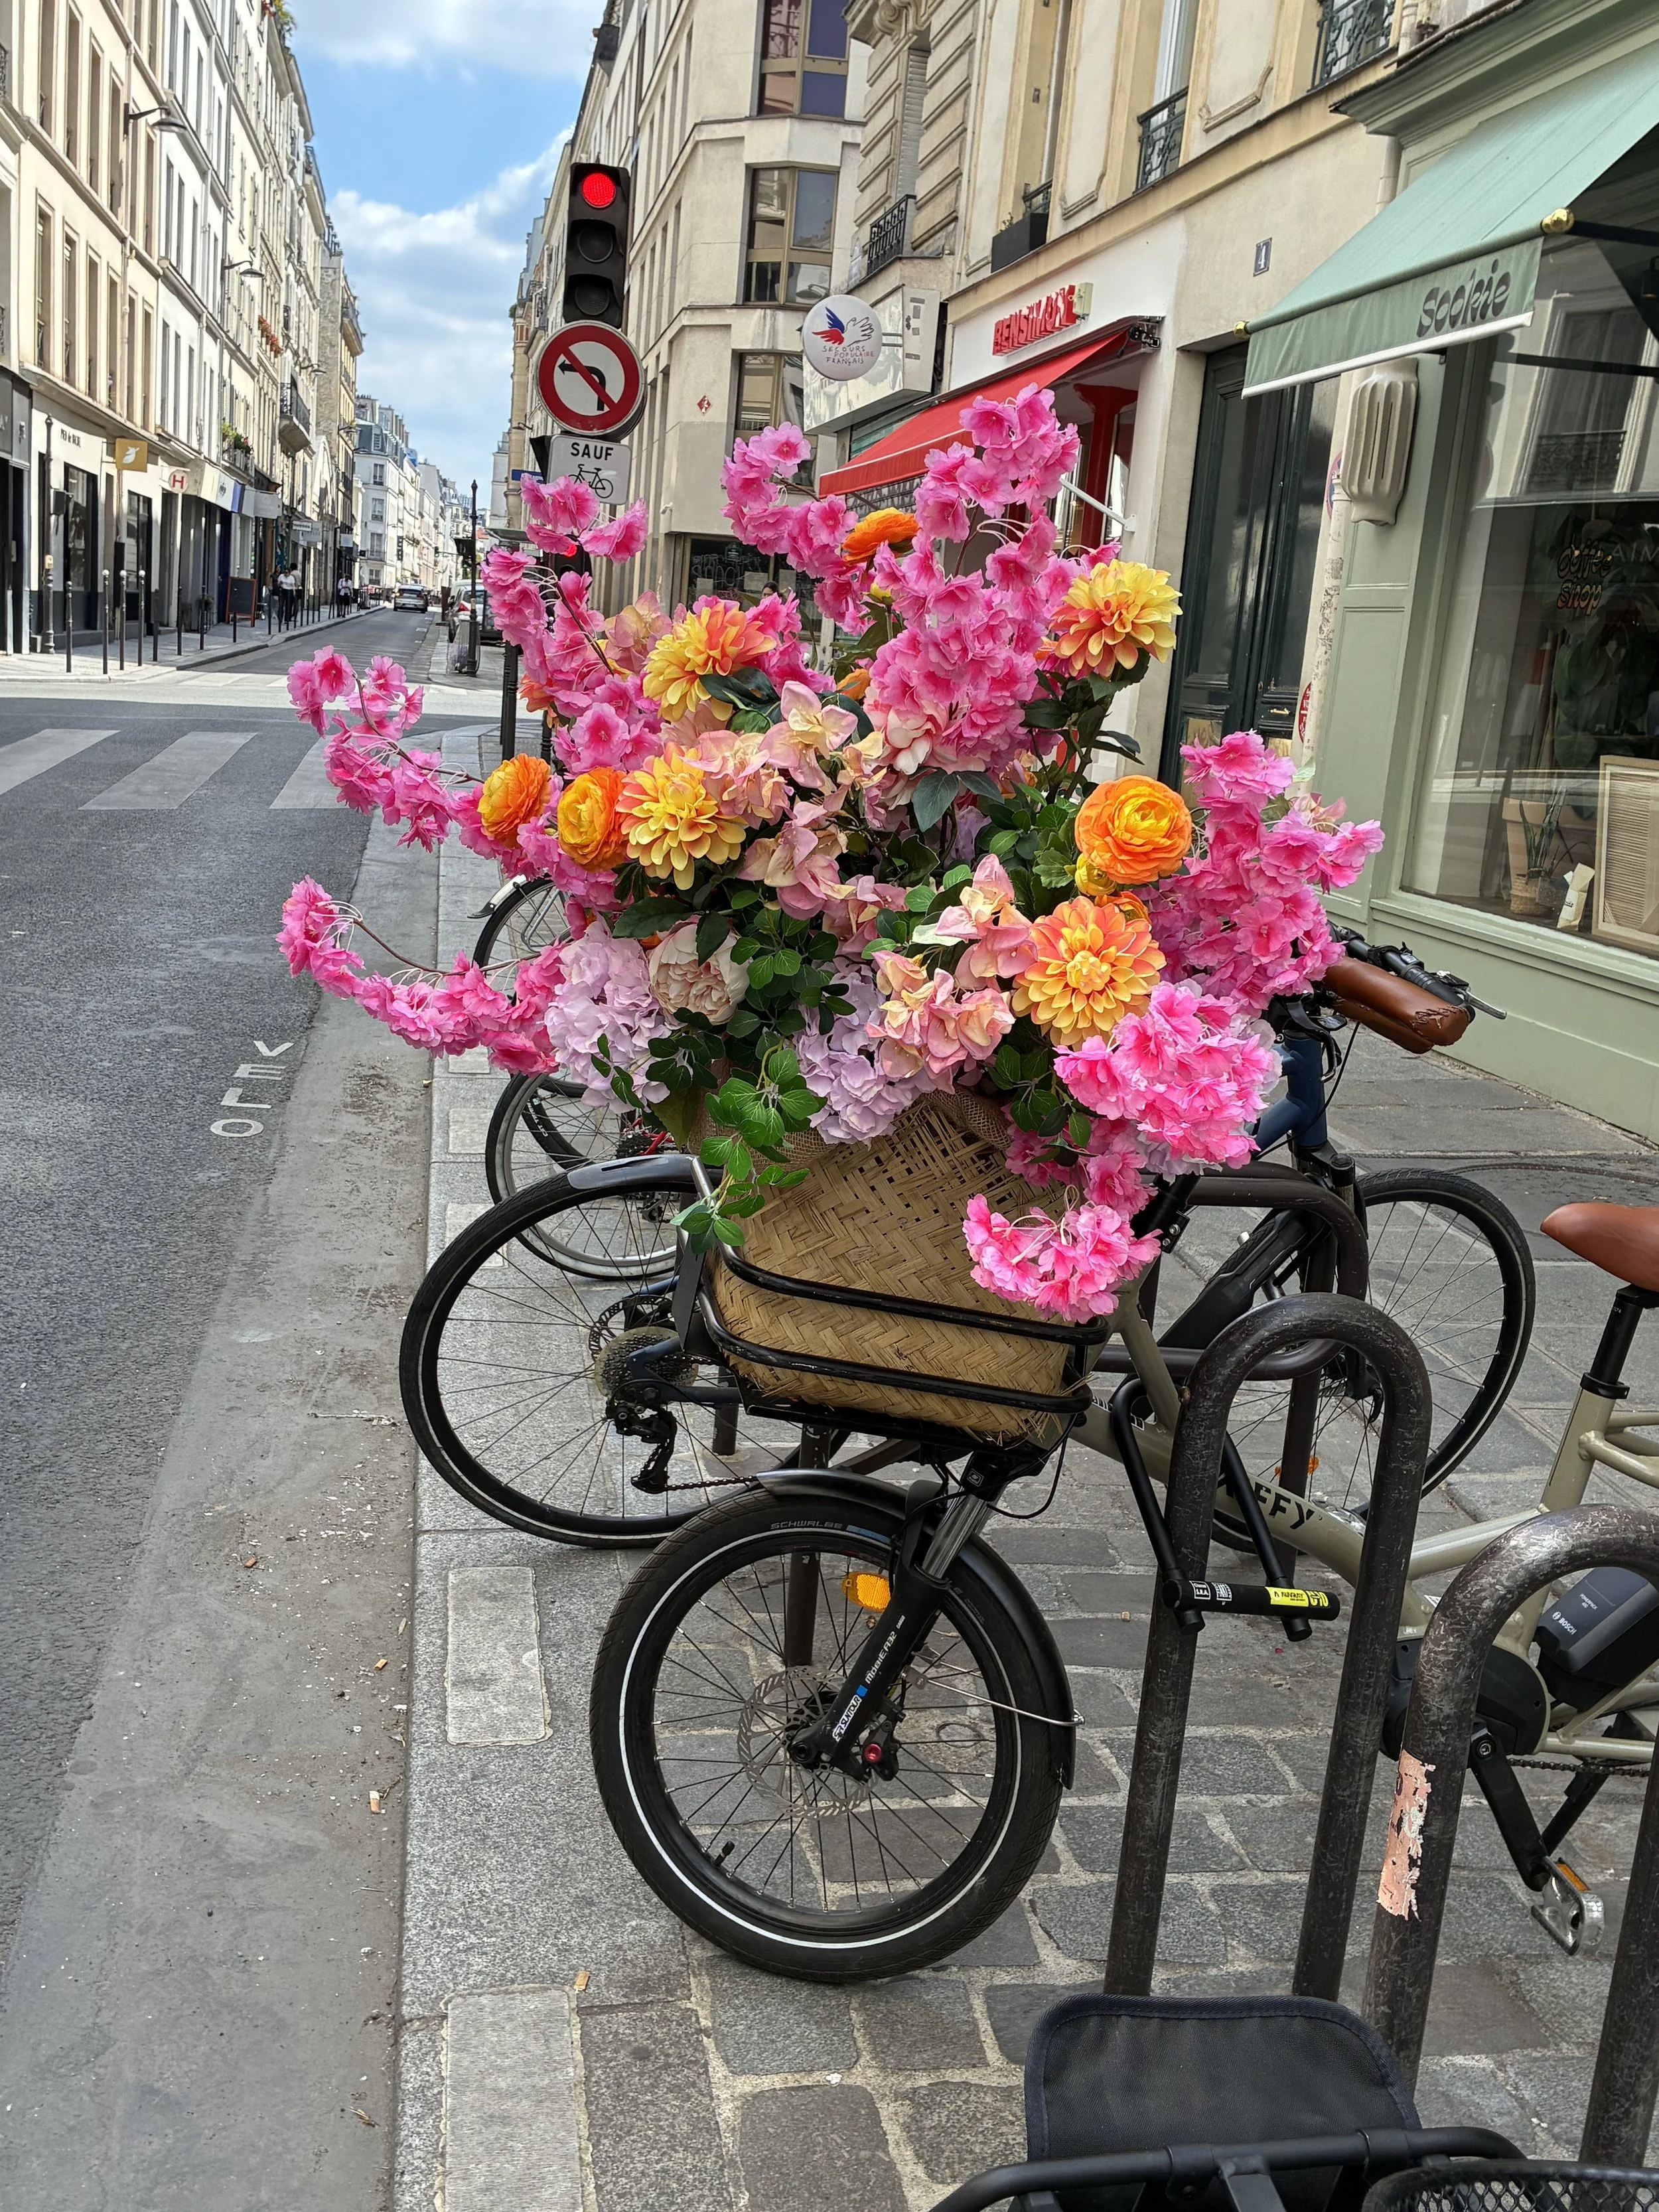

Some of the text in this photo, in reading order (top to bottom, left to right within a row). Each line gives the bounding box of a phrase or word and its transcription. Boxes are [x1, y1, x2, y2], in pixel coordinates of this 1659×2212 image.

[1416, 258, 1511, 338] Sookie
[826, 356, 864, 366] FRANÇAIS
[571, 442, 614, 461] SAUF
[172, 474, 184, 490] H
[1557, 538, 1613, 579] Coffee
[770, 1520, 843, 1530] SCHWALBE
[1558, 1617, 1577, 1635] BOSCH
[840, 1694, 862, 1733] SUNTOUR
